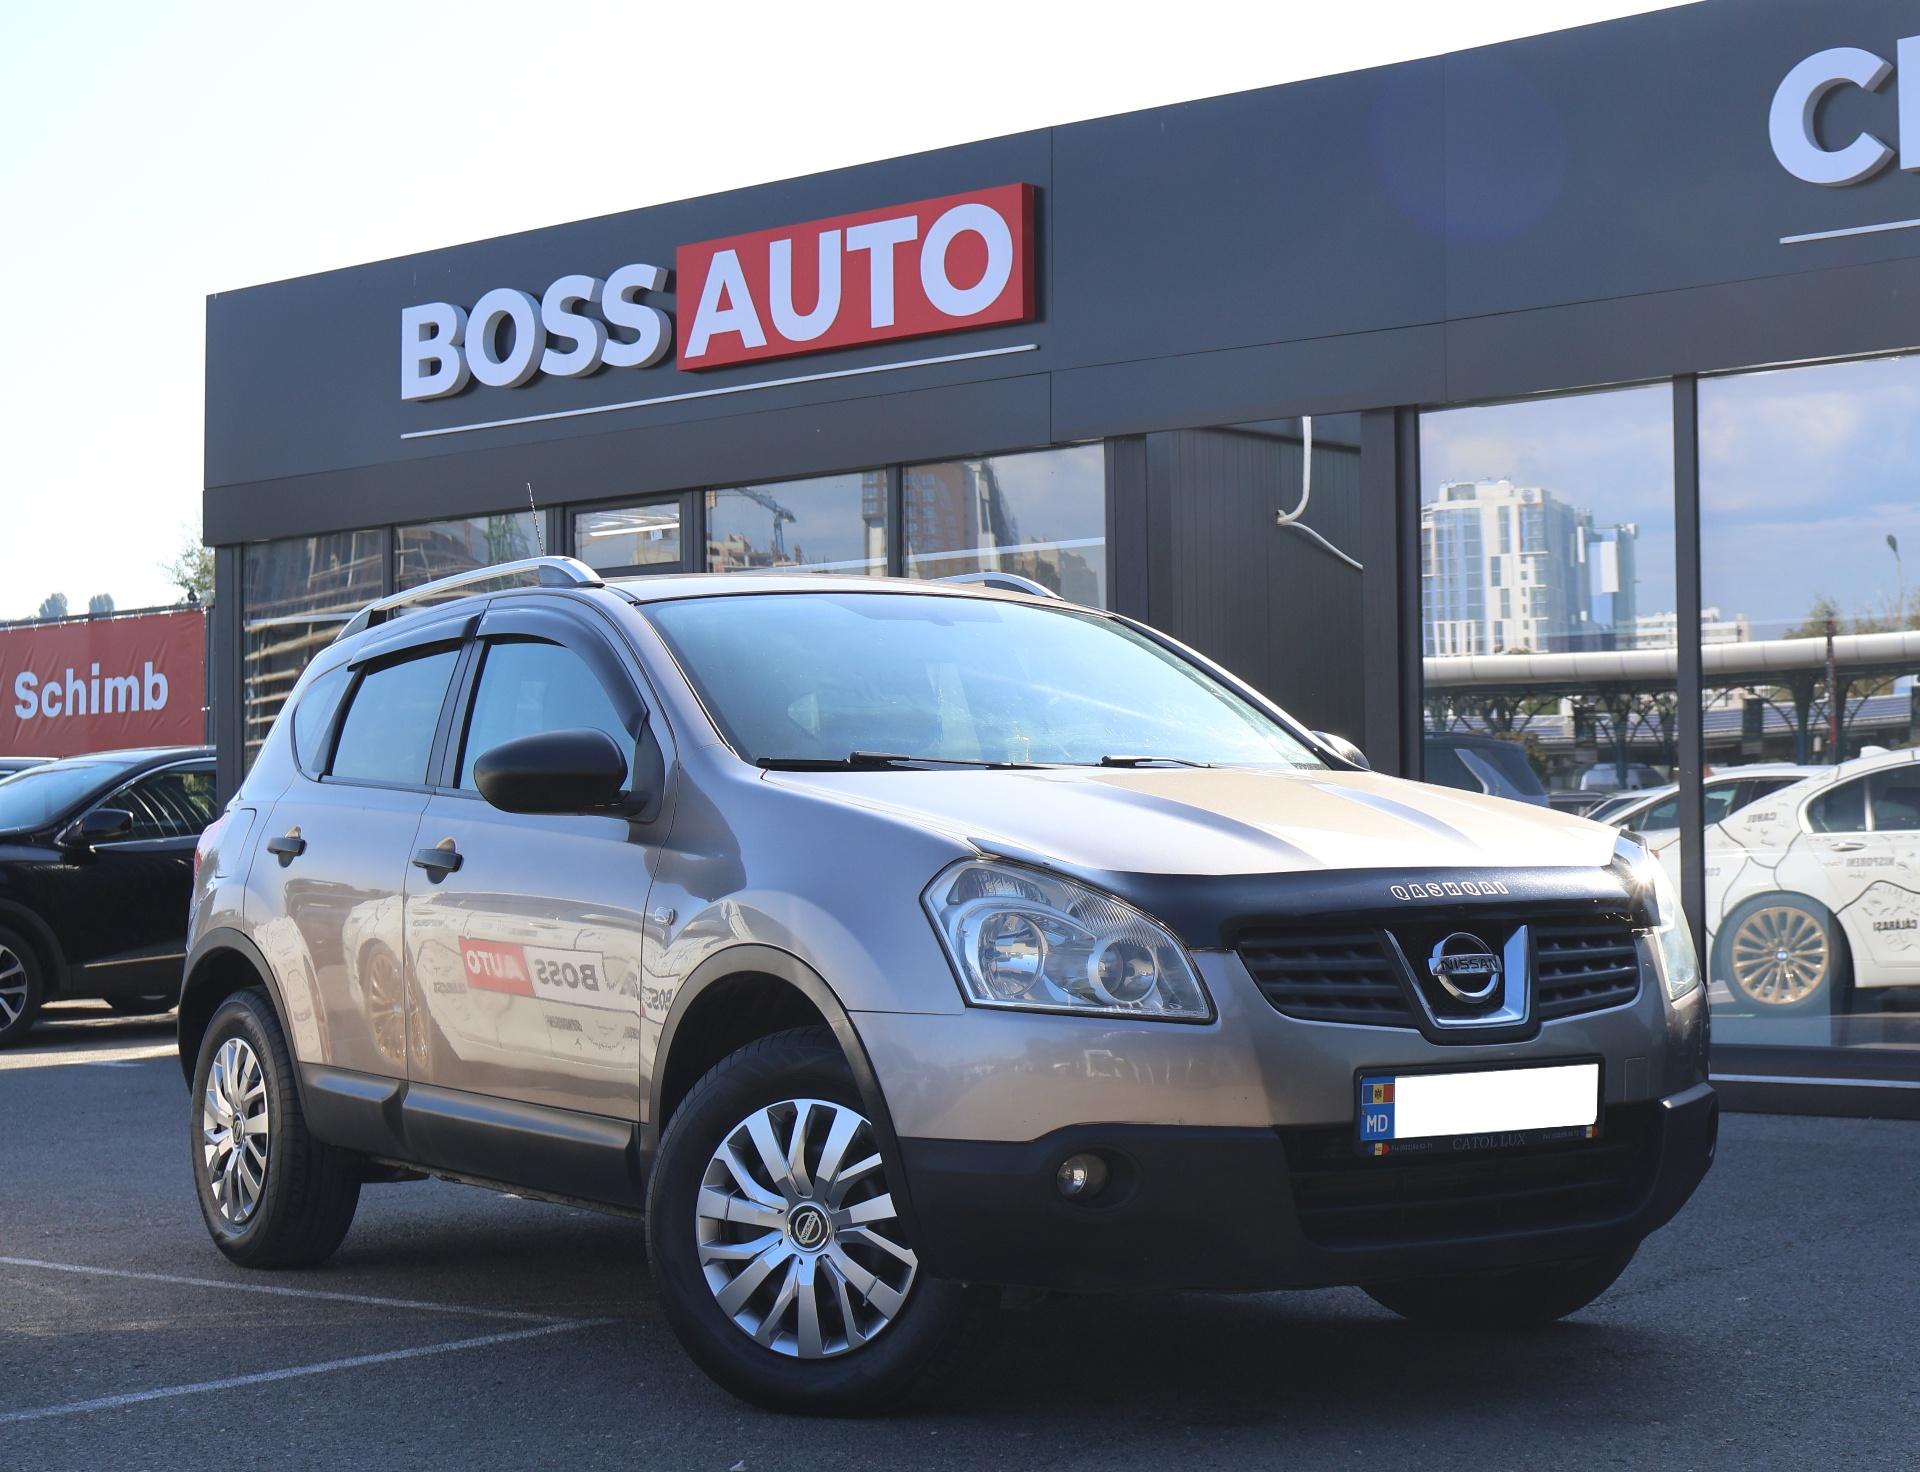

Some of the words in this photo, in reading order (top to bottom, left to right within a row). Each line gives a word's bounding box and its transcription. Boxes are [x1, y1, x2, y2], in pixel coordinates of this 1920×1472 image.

[401, 264, 671, 401] BOSS
[684, 203, 1014, 358] AUTO
[14, 661, 169, 720] Schimb
[1390, 881, 1510, 900] QASHQAI
[1441, 958, 1498, 971] NISSAN
[1366, 1114, 1388, 1133] MD
[1452, 1136, 1498, 1151] CATOL
[1500, 1133, 1528, 1147] LUX
[801, 1214, 816, 1241] NISSAN
